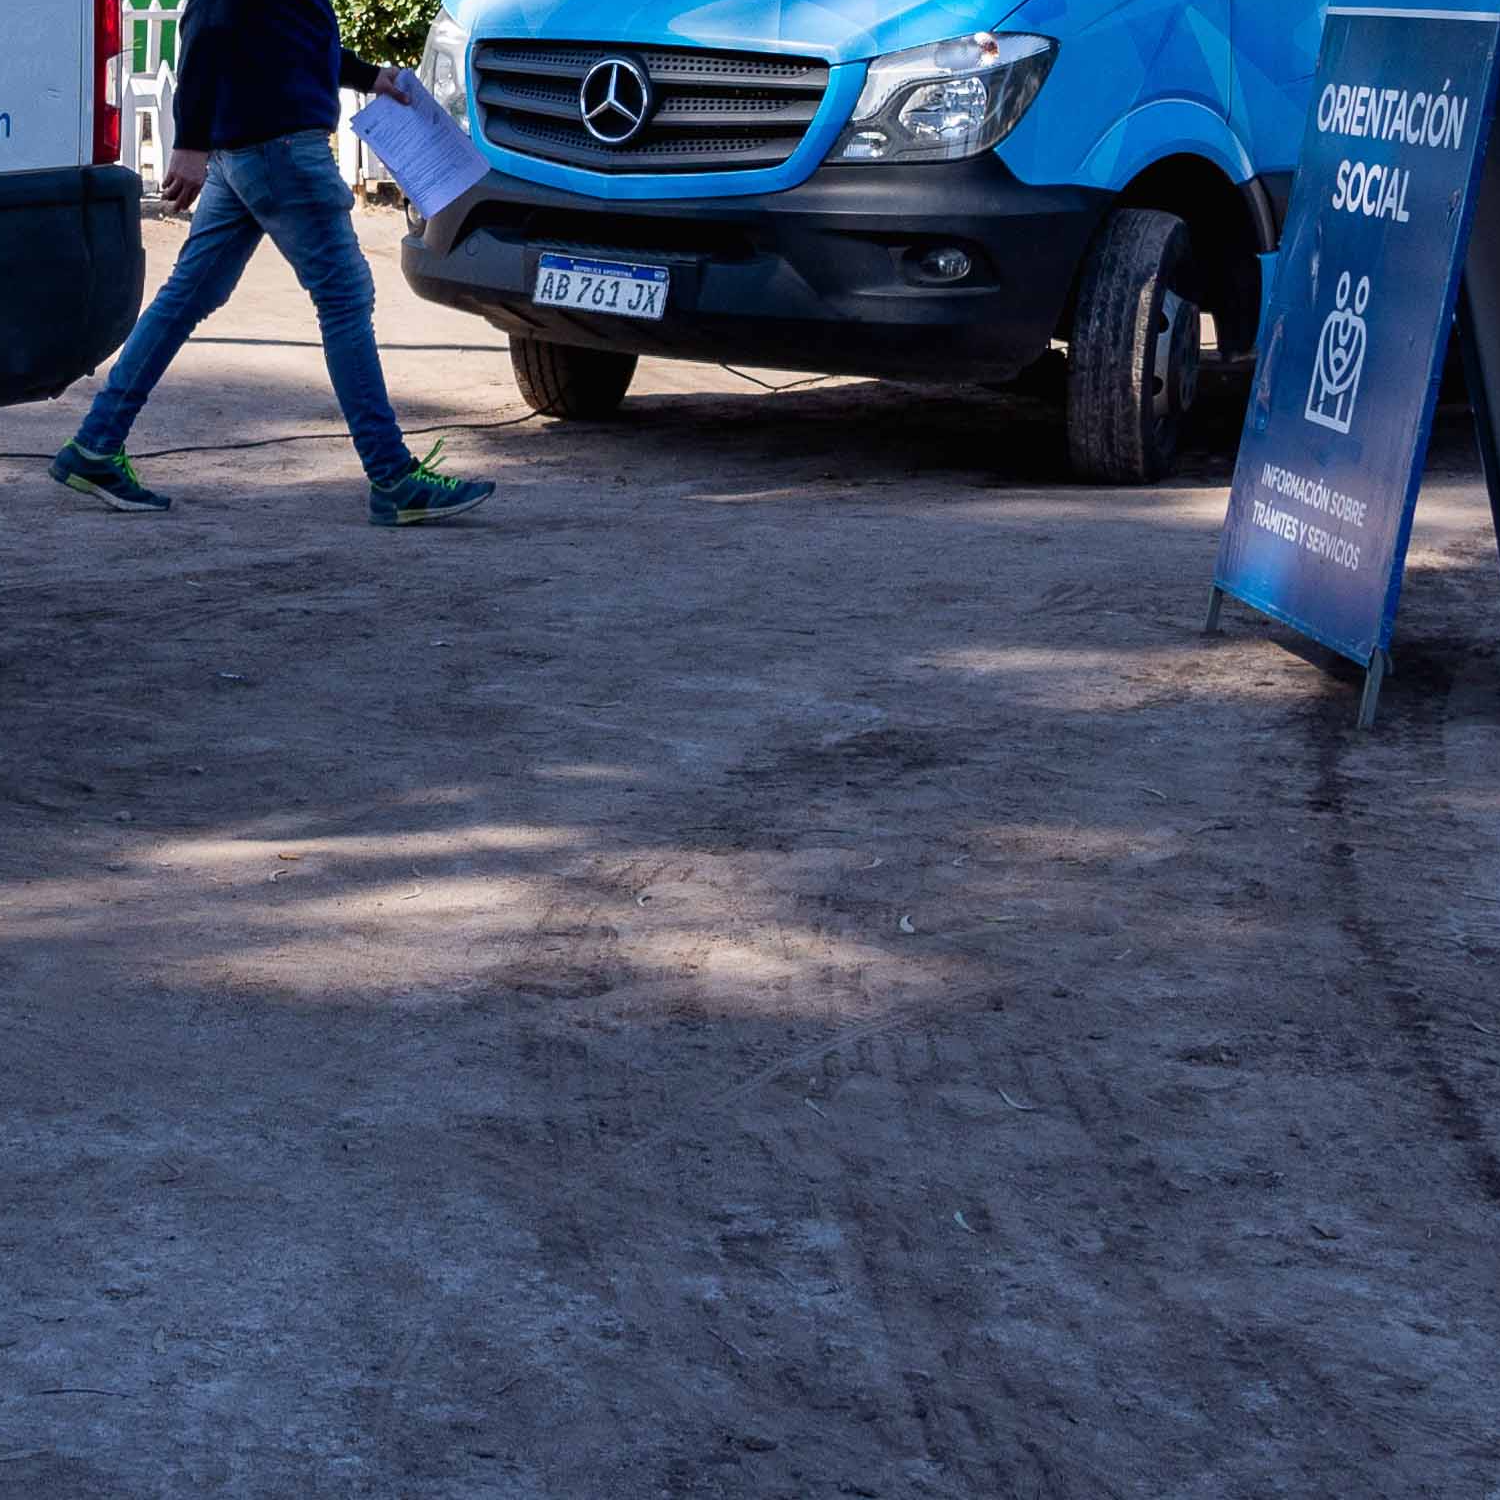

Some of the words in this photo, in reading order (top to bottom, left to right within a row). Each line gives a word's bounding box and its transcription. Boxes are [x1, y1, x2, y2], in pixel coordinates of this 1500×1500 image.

[1317, 79, 1468, 149] ORIENTACIÓN
[1332, 159, 1410, 222] SOCIAL
[541, 272, 570, 300] AB
[576, 276, 621, 308] 761
[628, 284, 659, 313] JX
[1262, 462, 1330, 512] INFORMACIÓN
[1330, 492, 1367, 527] SOBRE
[1253, 500, 1299, 542] TRÁMITES
[1299, 522, 1307, 545] Y
[1306, 526, 1360, 571] SERVICIOS
